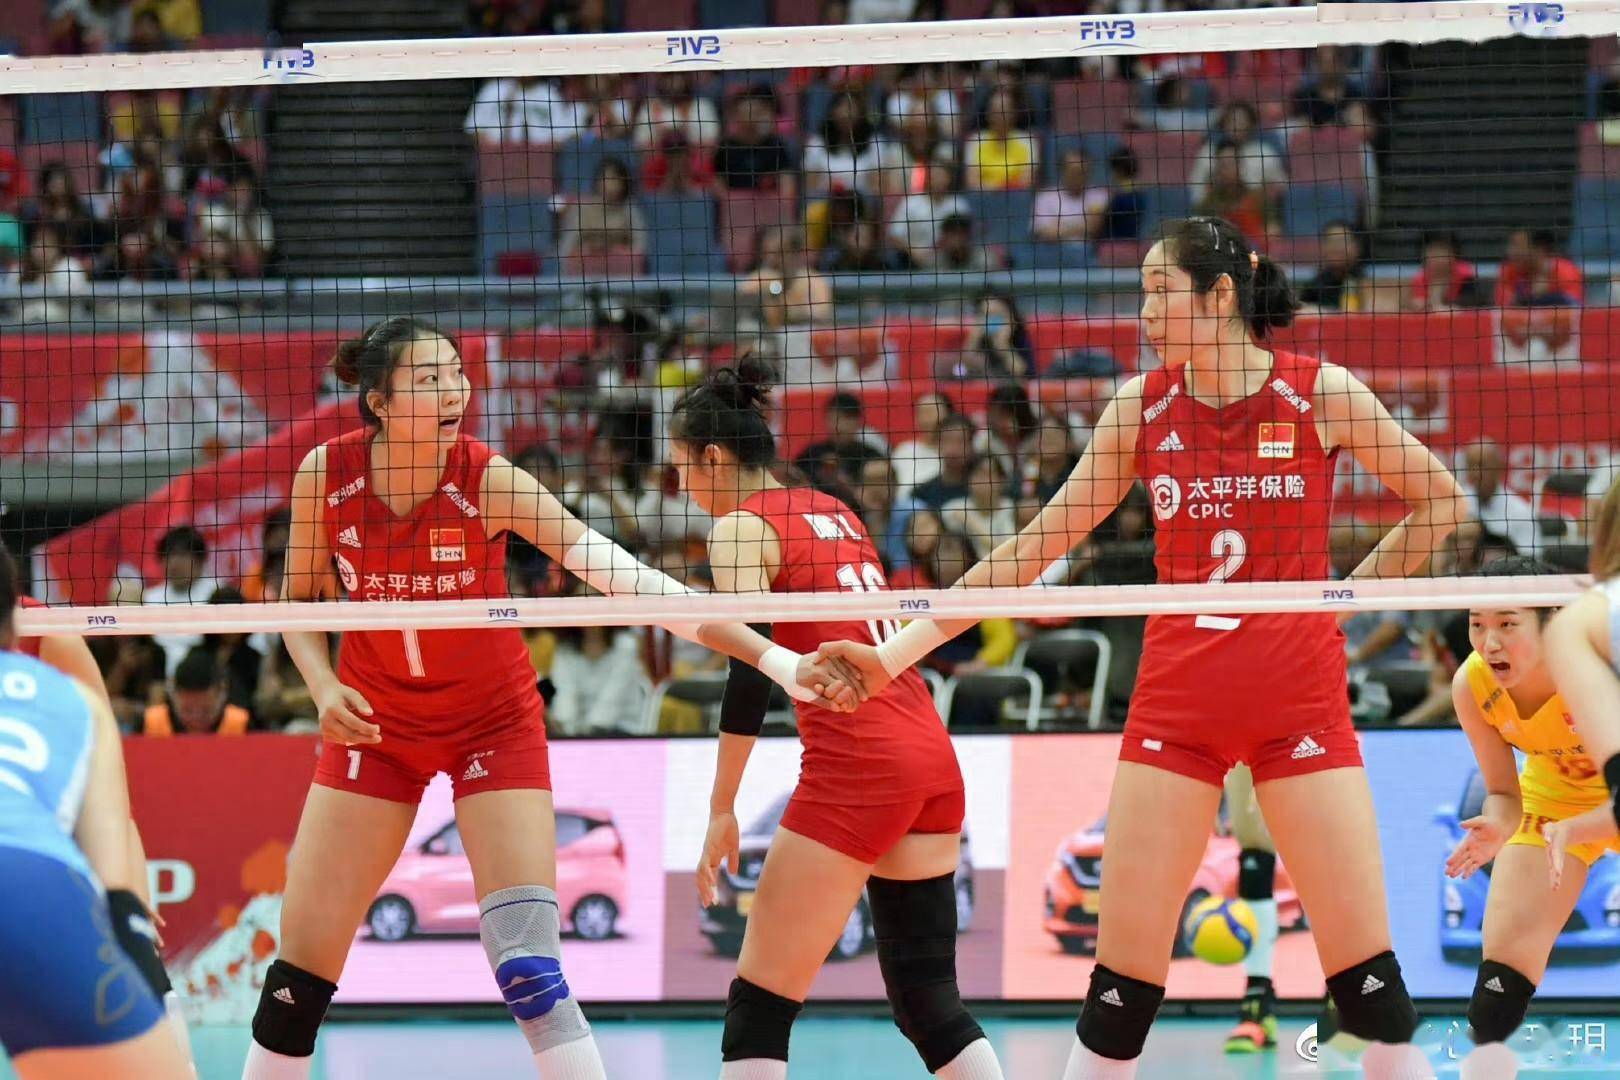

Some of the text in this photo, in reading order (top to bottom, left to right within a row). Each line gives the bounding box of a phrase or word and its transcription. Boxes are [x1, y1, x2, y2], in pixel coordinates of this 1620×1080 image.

[1080, 20, 1136, 40] FIVB
[666, 36, 721, 56] FIVB
[1187, 475, 1305, 500] 太平洋保险
[1188, 503, 1234, 519] CPIC
[364, 567, 477, 593] 太平洋保险
[1195, 529, 1246, 631] 2
[900, 599, 929, 609] FIVB
[1322, 590, 1354, 600] FIVB
[87, 616, 117, 625] FIVB
[488, 608, 518, 618] FIVB
[347, 749, 362, 780] 1
